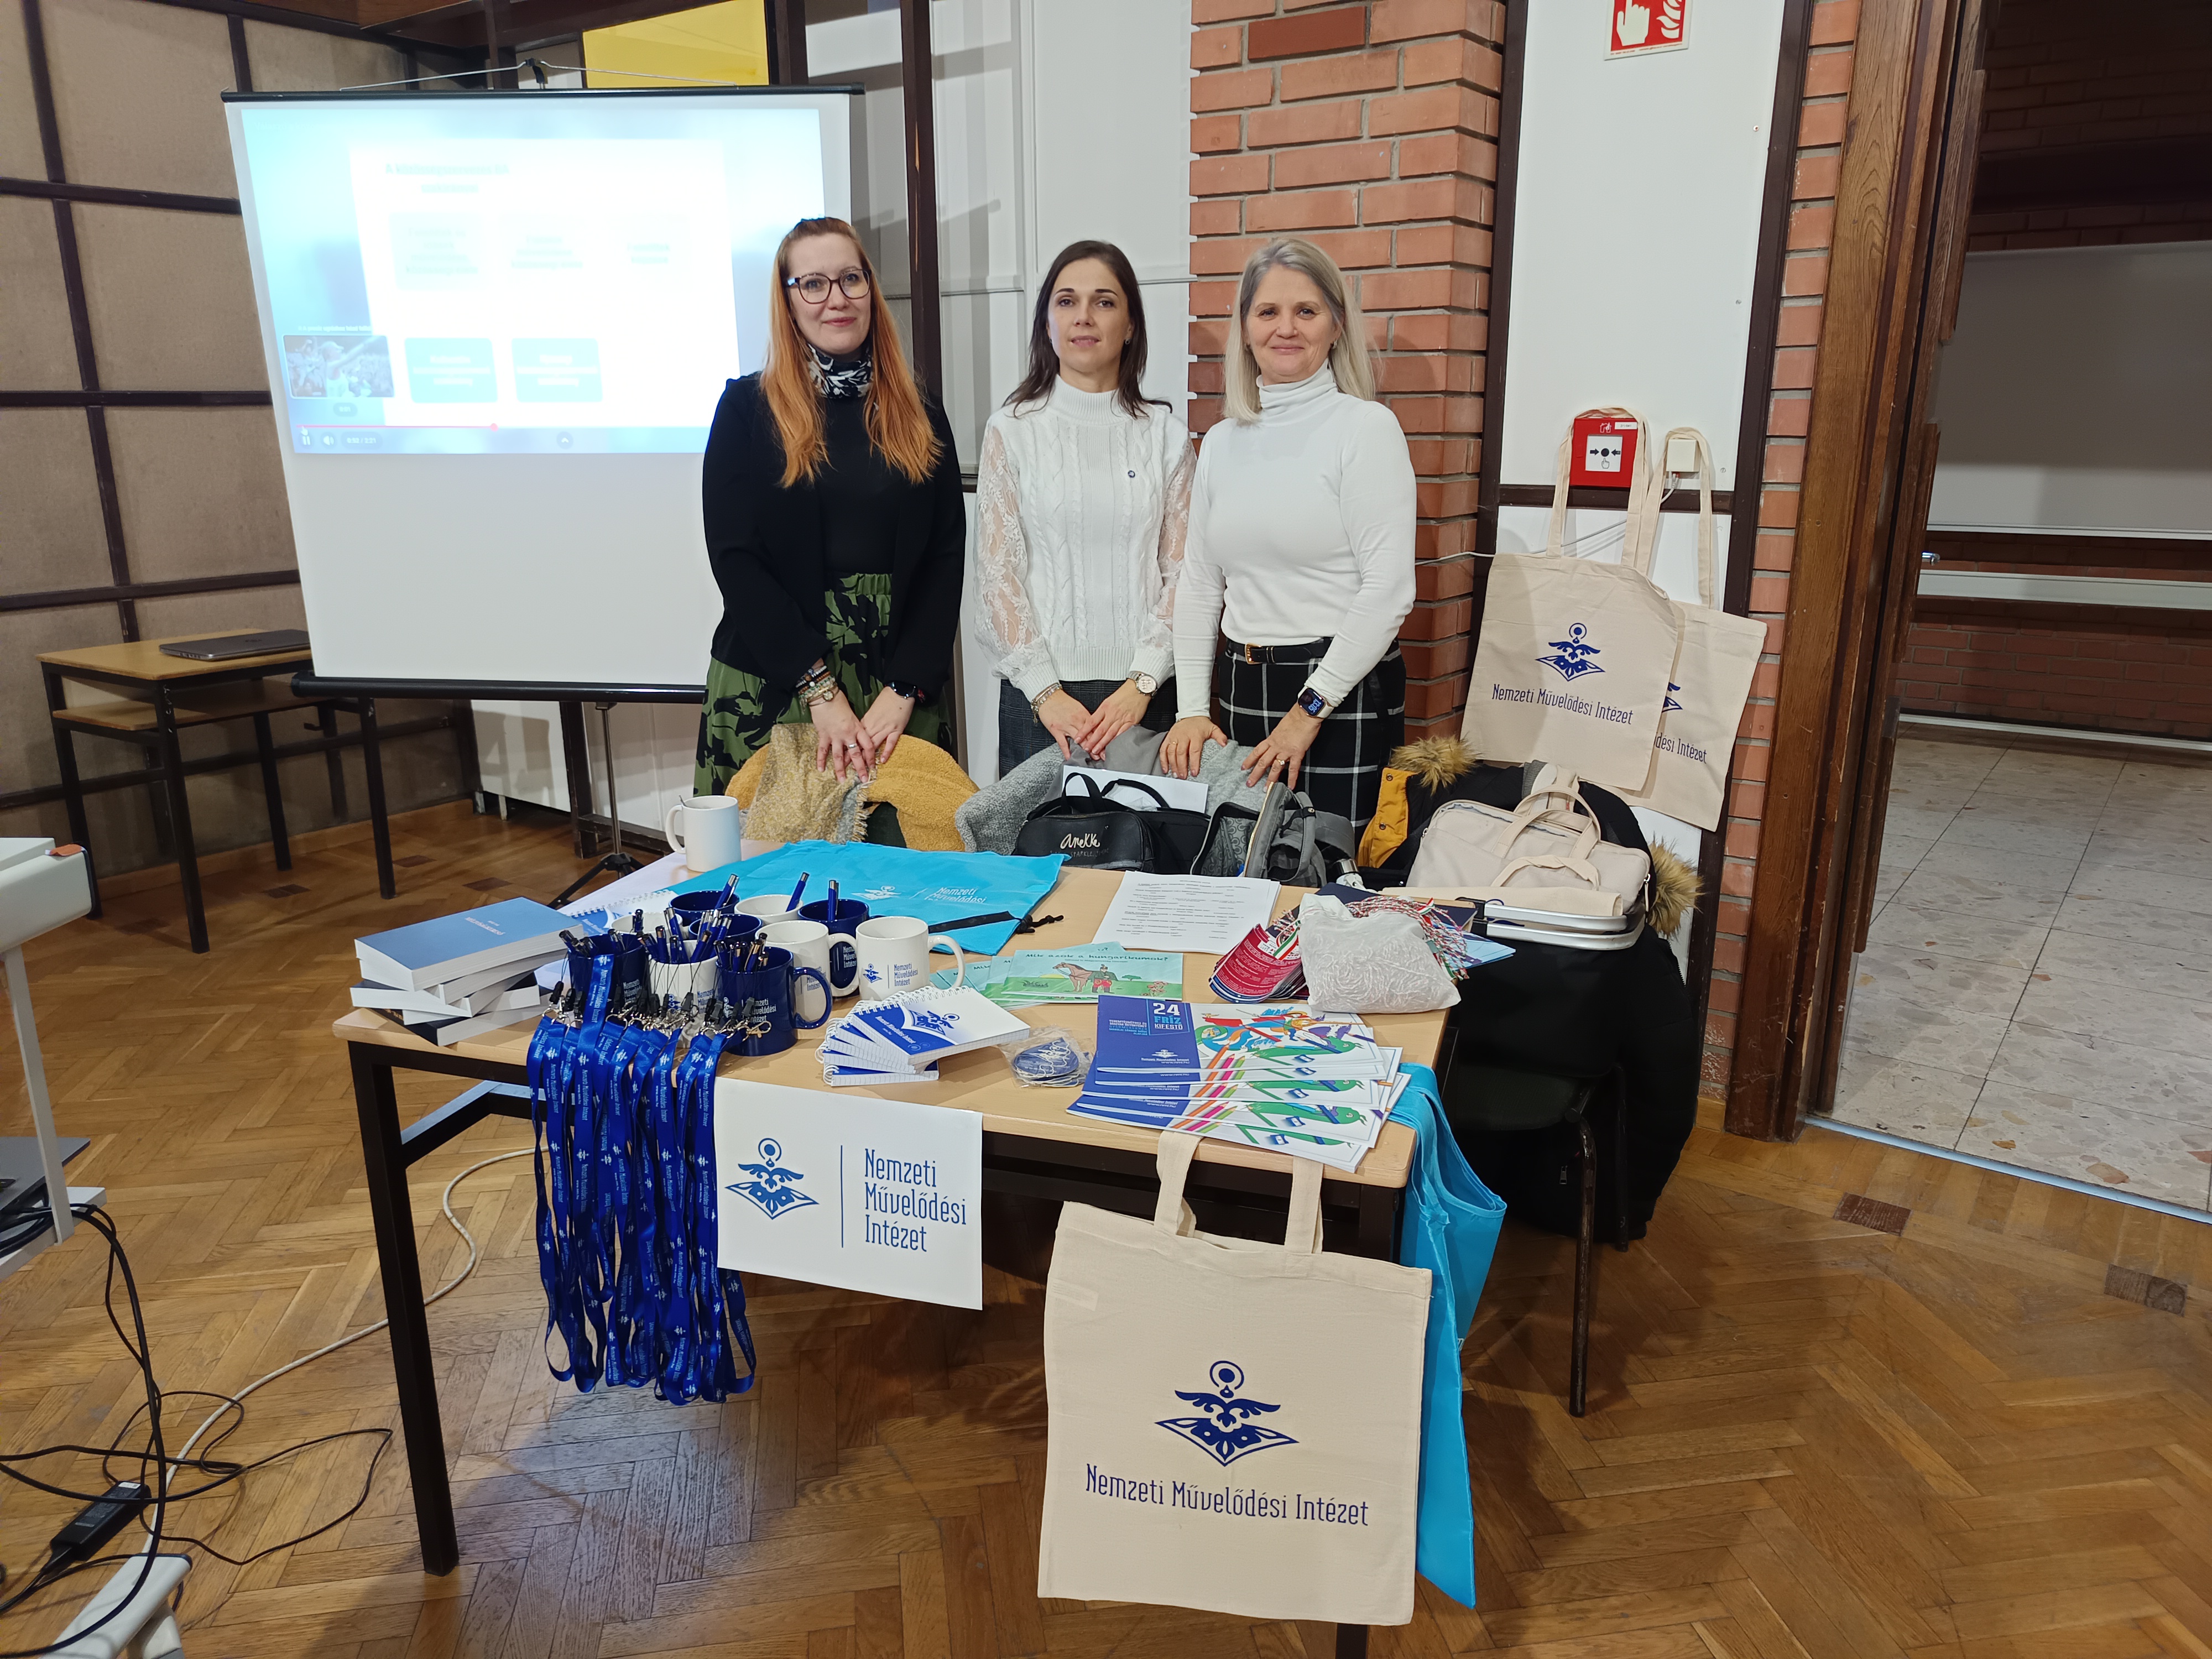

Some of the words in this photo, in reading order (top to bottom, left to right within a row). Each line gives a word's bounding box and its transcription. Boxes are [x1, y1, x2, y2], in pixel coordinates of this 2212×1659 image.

[1492, 684, 1534, 703] Nemzeti
[1537, 688, 1593, 717] Művelődési
[1595, 701, 1634, 725] Intézet
[1677, 738, 1707, 764] Intézet
[937, 886, 979, 895] Nemzeti
[894, 962, 912, 972] Nemzeti
[894, 969, 919, 979] Művelődési
[894, 978, 910, 987] Intézet
[754, 998, 769, 1006] mzeti
[752, 1004, 776, 1015] űvelődési
[1153, 1003, 1180, 1016] 24
[592, 1009, 601, 1023] Intézet
[749, 1015, 767, 1024] ntézet
[1154, 1015, 1181, 1024] FRÍZ
[864, 1147, 937, 1188] Nemzeti
[864, 1182, 967, 1225] Művelődési
[865, 1214, 927, 1253] Intézet
[1086, 1463, 1164, 1506] Nemzeti
[1171, 1480, 1287, 1520] Művelődési
[1295, 1493, 1369, 1527] Intézet
